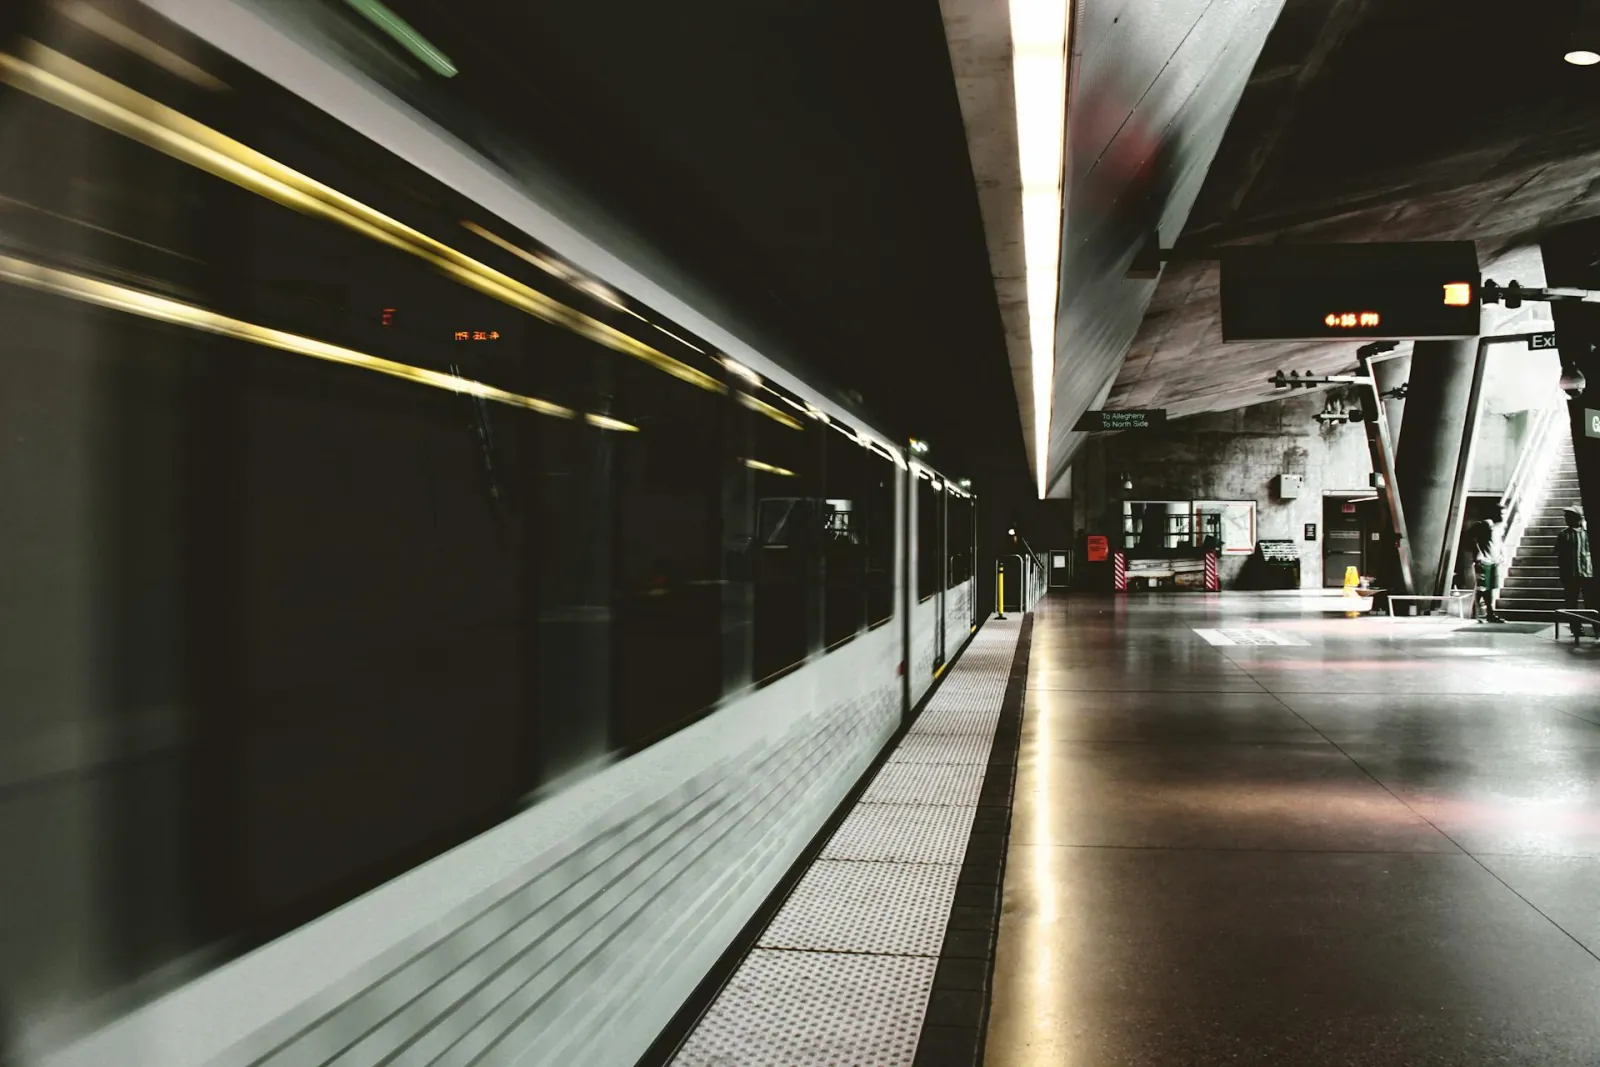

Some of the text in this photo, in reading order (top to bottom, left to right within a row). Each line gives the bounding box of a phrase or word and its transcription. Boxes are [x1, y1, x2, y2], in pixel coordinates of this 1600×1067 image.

[1532, 334, 1556, 348] Exi
[1112, 413, 1145, 421] Allegheny
[1133, 420, 1149, 428] Side
